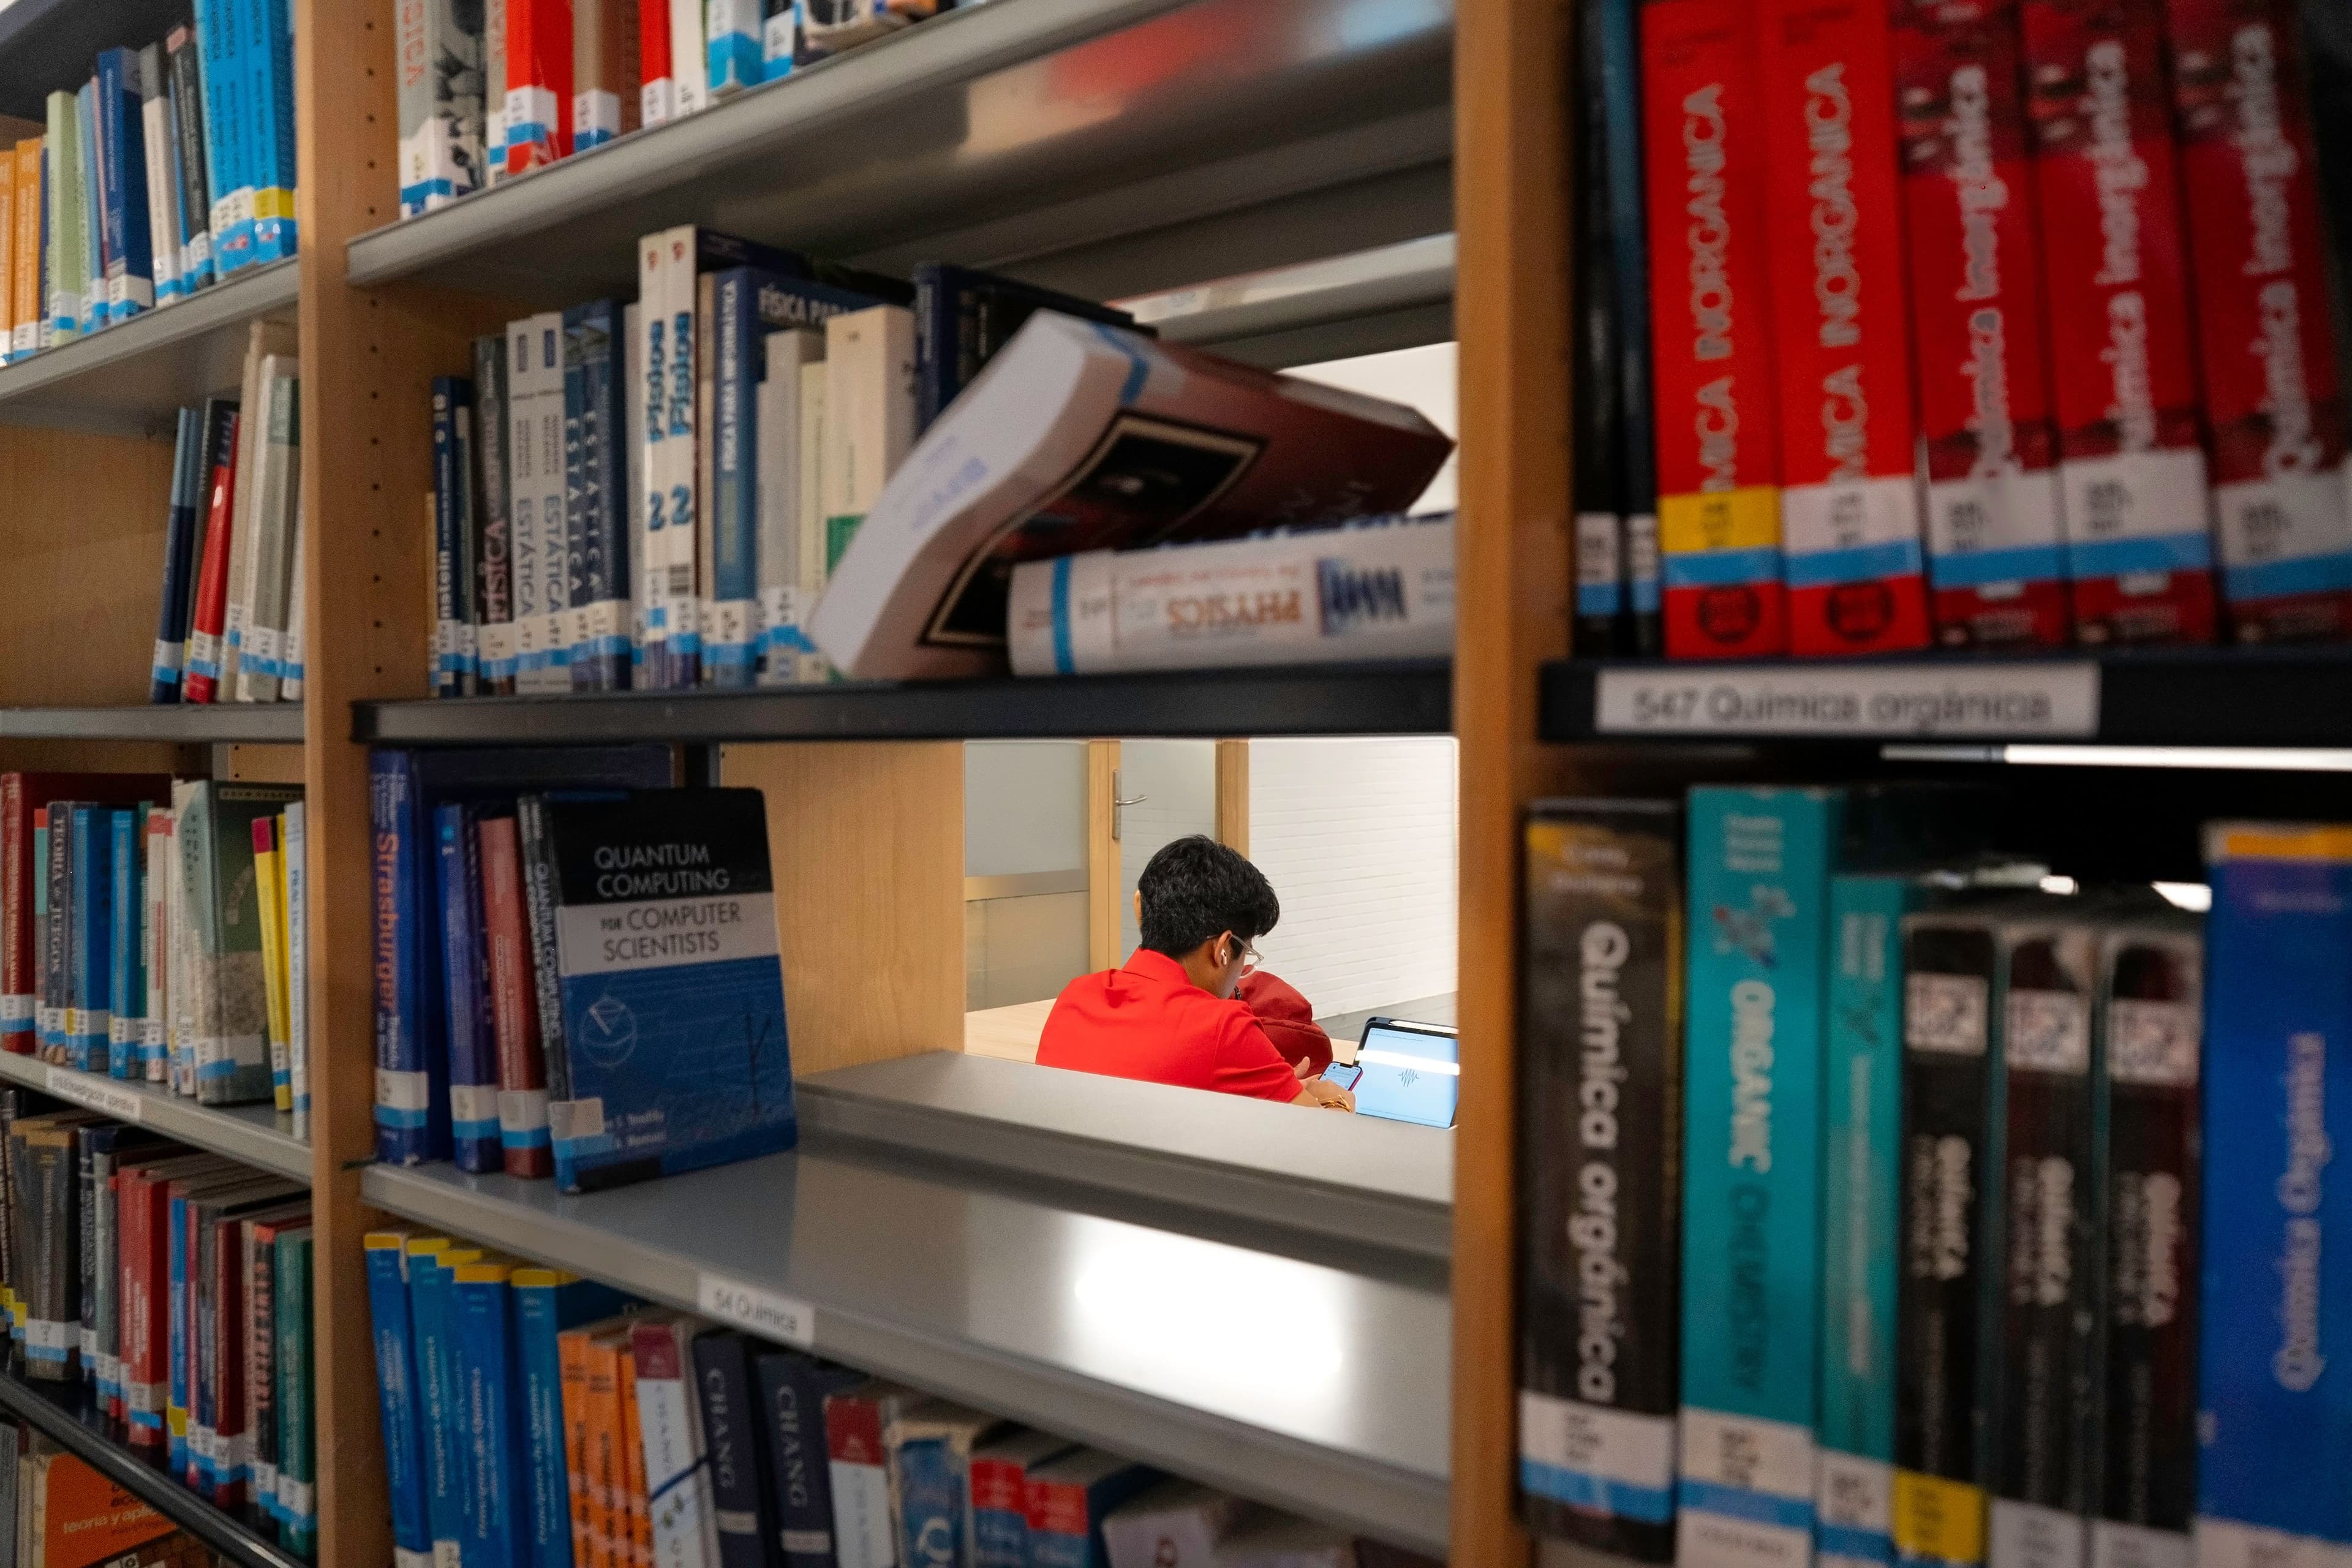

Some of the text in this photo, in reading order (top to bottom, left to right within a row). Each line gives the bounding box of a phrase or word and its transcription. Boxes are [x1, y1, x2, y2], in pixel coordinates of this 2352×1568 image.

[1822, 365, 1868, 486] MICA
[2100, 291, 2157, 453] uímica
[1695, 376, 1739, 492] MICA
[670, 483, 693, 526] 2
[437, 551, 452, 620] nstein
[1166, 588, 1302, 634] PHYSICS
[1632, 685, 1700, 724] 547
[594, 843, 710, 869] QUANTUM
[596, 868, 730, 898] COMPUTING
[375, 832, 399, 1011] Strasburger
[535, 862, 562, 1039] QUANTUM COMPUTING
[603, 930, 720, 962] SCIENTISTS
[627, 902, 742, 931] COMPUTER
[1580, 921, 1632, 1150] Química
[1728, 979, 1775, 1174] ORGANIC
[1568, 1163, 1629, 1402] orgánica
[705, 1367, 736, 1489] CHANG
[777, 1384, 809, 1507] CHANG
